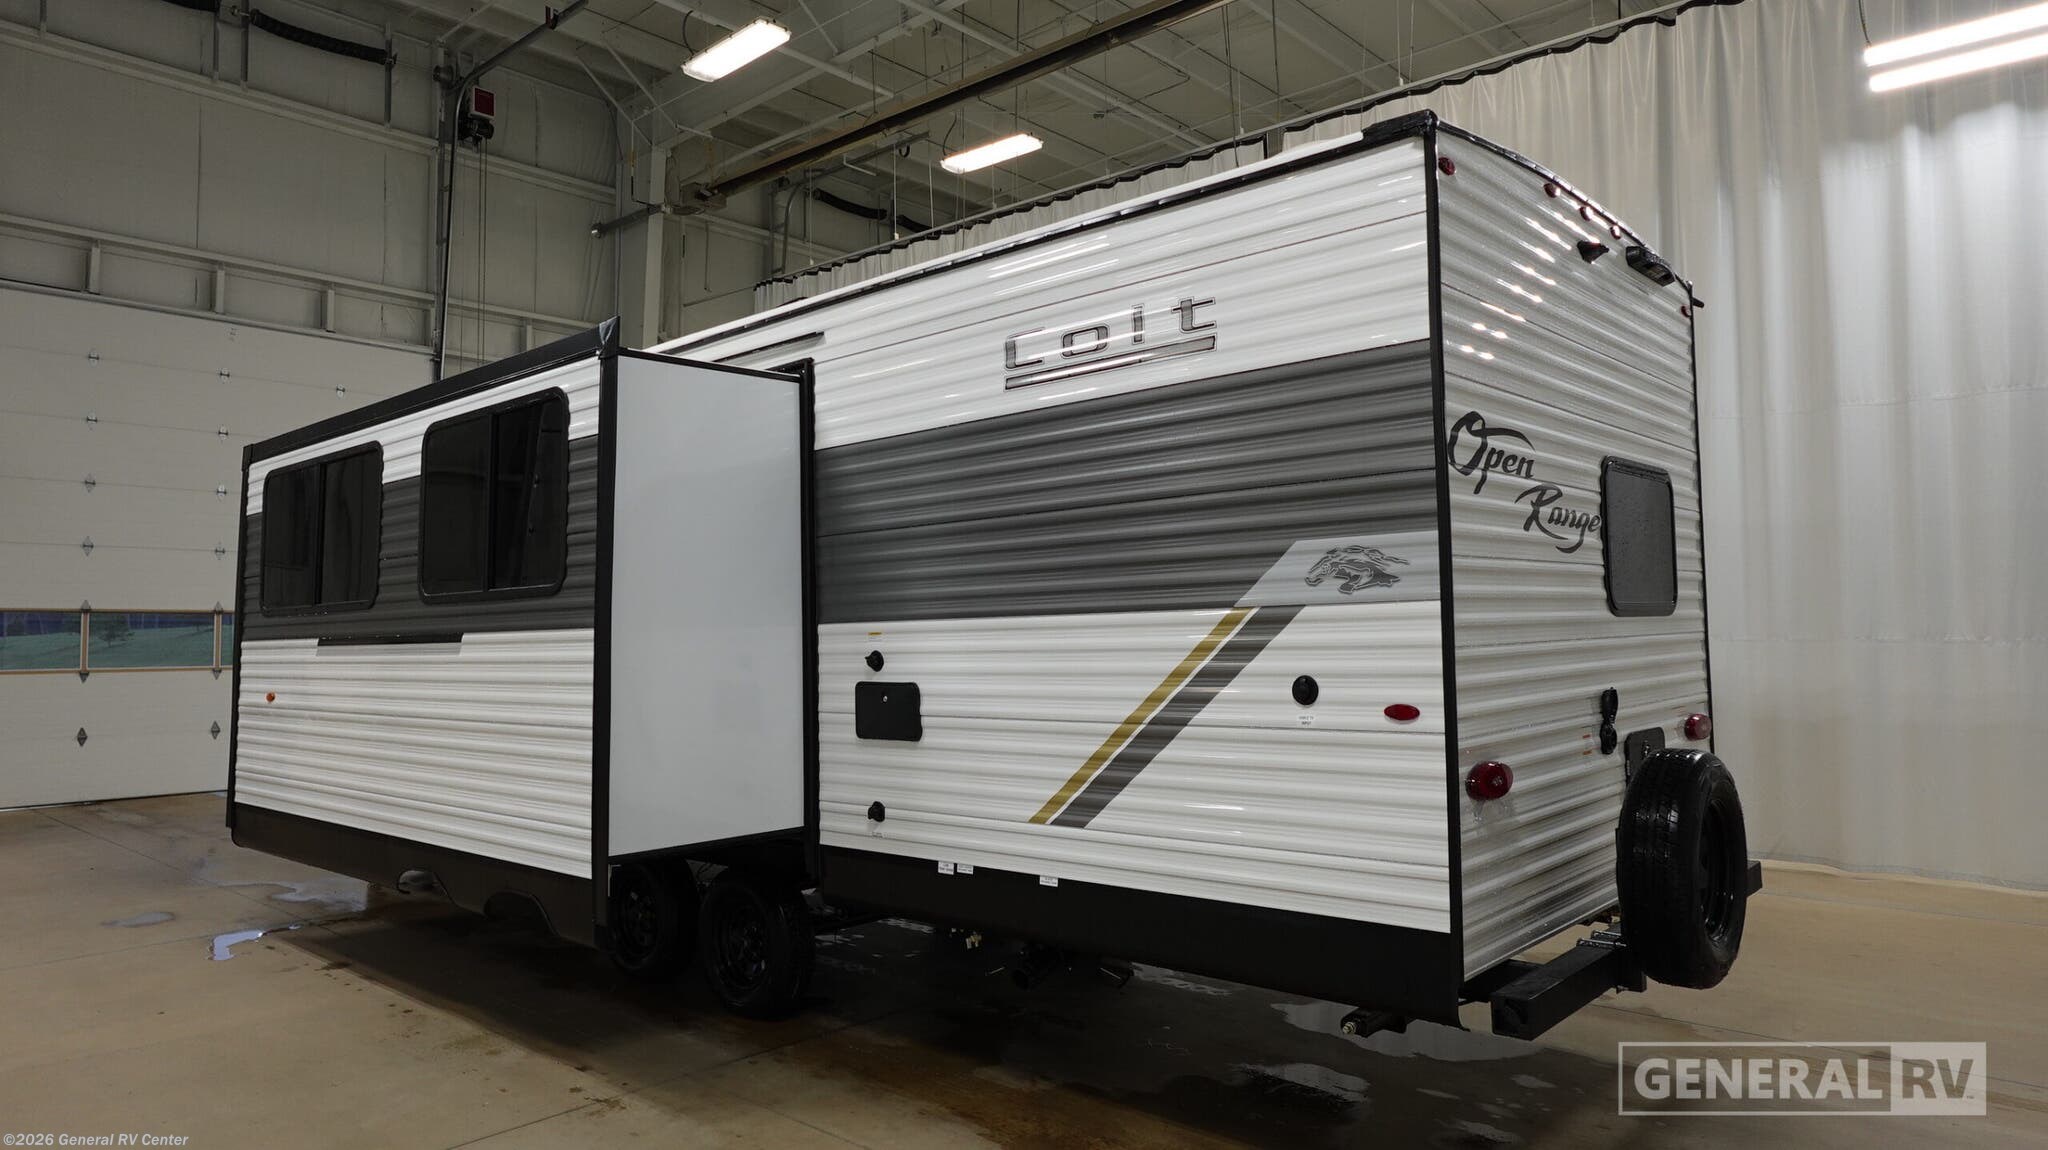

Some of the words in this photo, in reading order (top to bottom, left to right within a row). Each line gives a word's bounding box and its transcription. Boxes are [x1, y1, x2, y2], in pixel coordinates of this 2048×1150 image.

[1004, 296, 1217, 370] Colt
[1448, 411, 1535, 494] Open
[1514, 483, 1601, 553] Range
